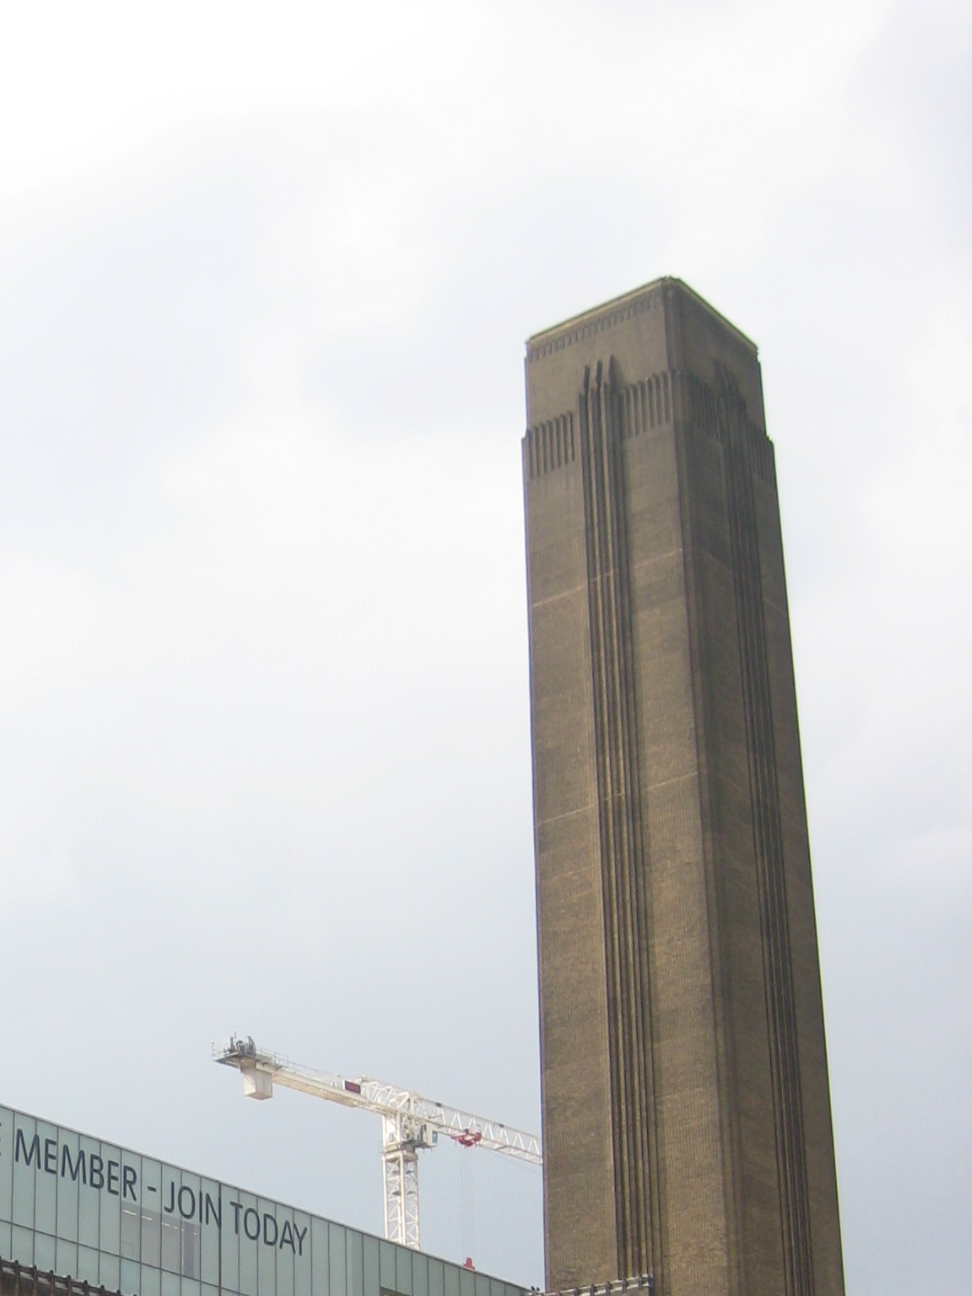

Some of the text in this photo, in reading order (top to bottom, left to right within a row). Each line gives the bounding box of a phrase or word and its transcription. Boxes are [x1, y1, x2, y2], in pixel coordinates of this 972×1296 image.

[15, 1128, 137, 1201] MEMBER
[147, 1185, 157, 1193] -
[164, 1180, 222, 1228] JOIN
[230, 1201, 308, 1257] TODAY
